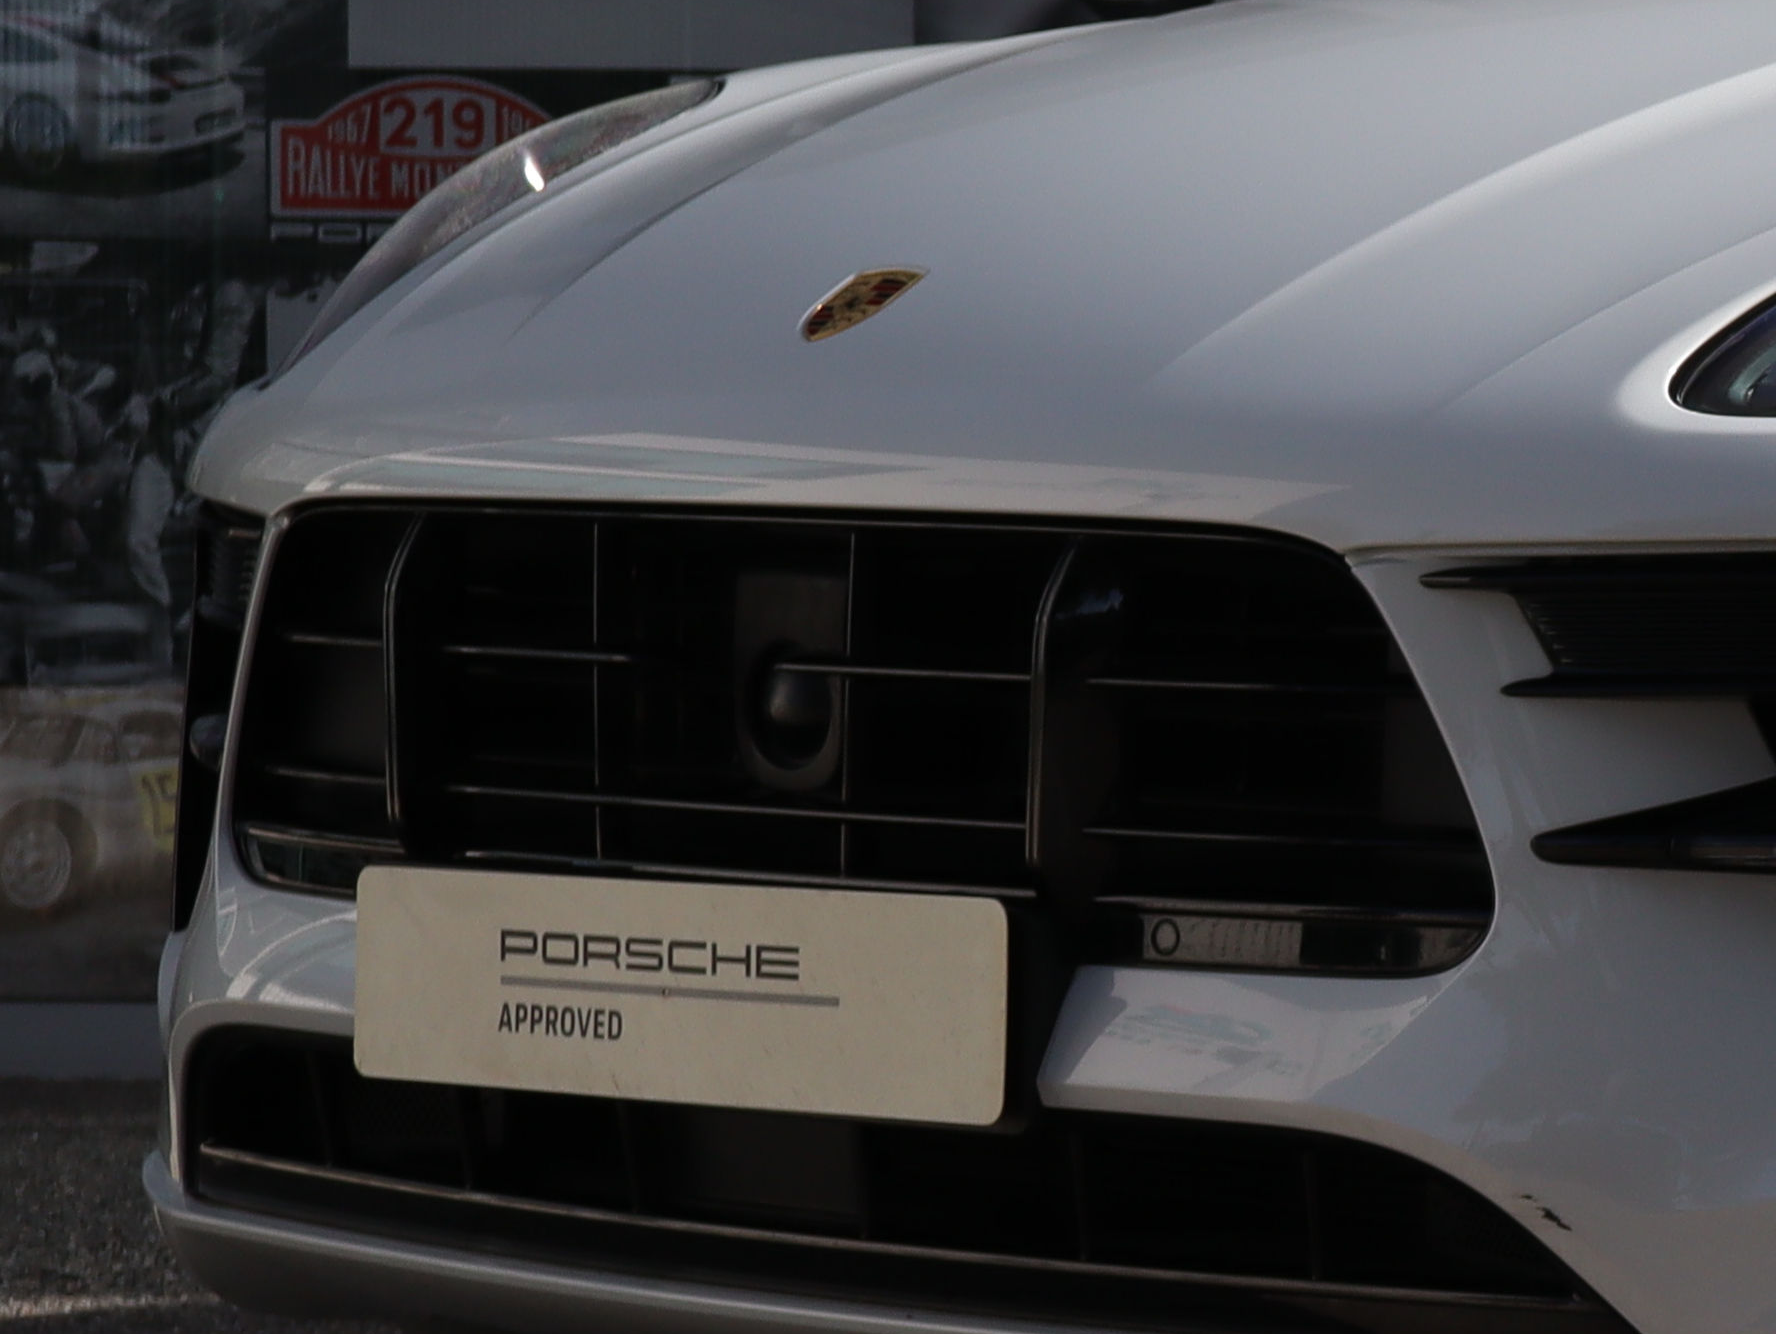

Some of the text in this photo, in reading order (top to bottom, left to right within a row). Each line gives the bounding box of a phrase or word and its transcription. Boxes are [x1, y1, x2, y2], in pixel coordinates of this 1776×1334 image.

[383, 97, 484, 149] 219
[287, 136, 379, 199] RALLYE
[499, 929, 801, 981] PORSCHE
[497, 1002, 624, 1042] APPROVED
